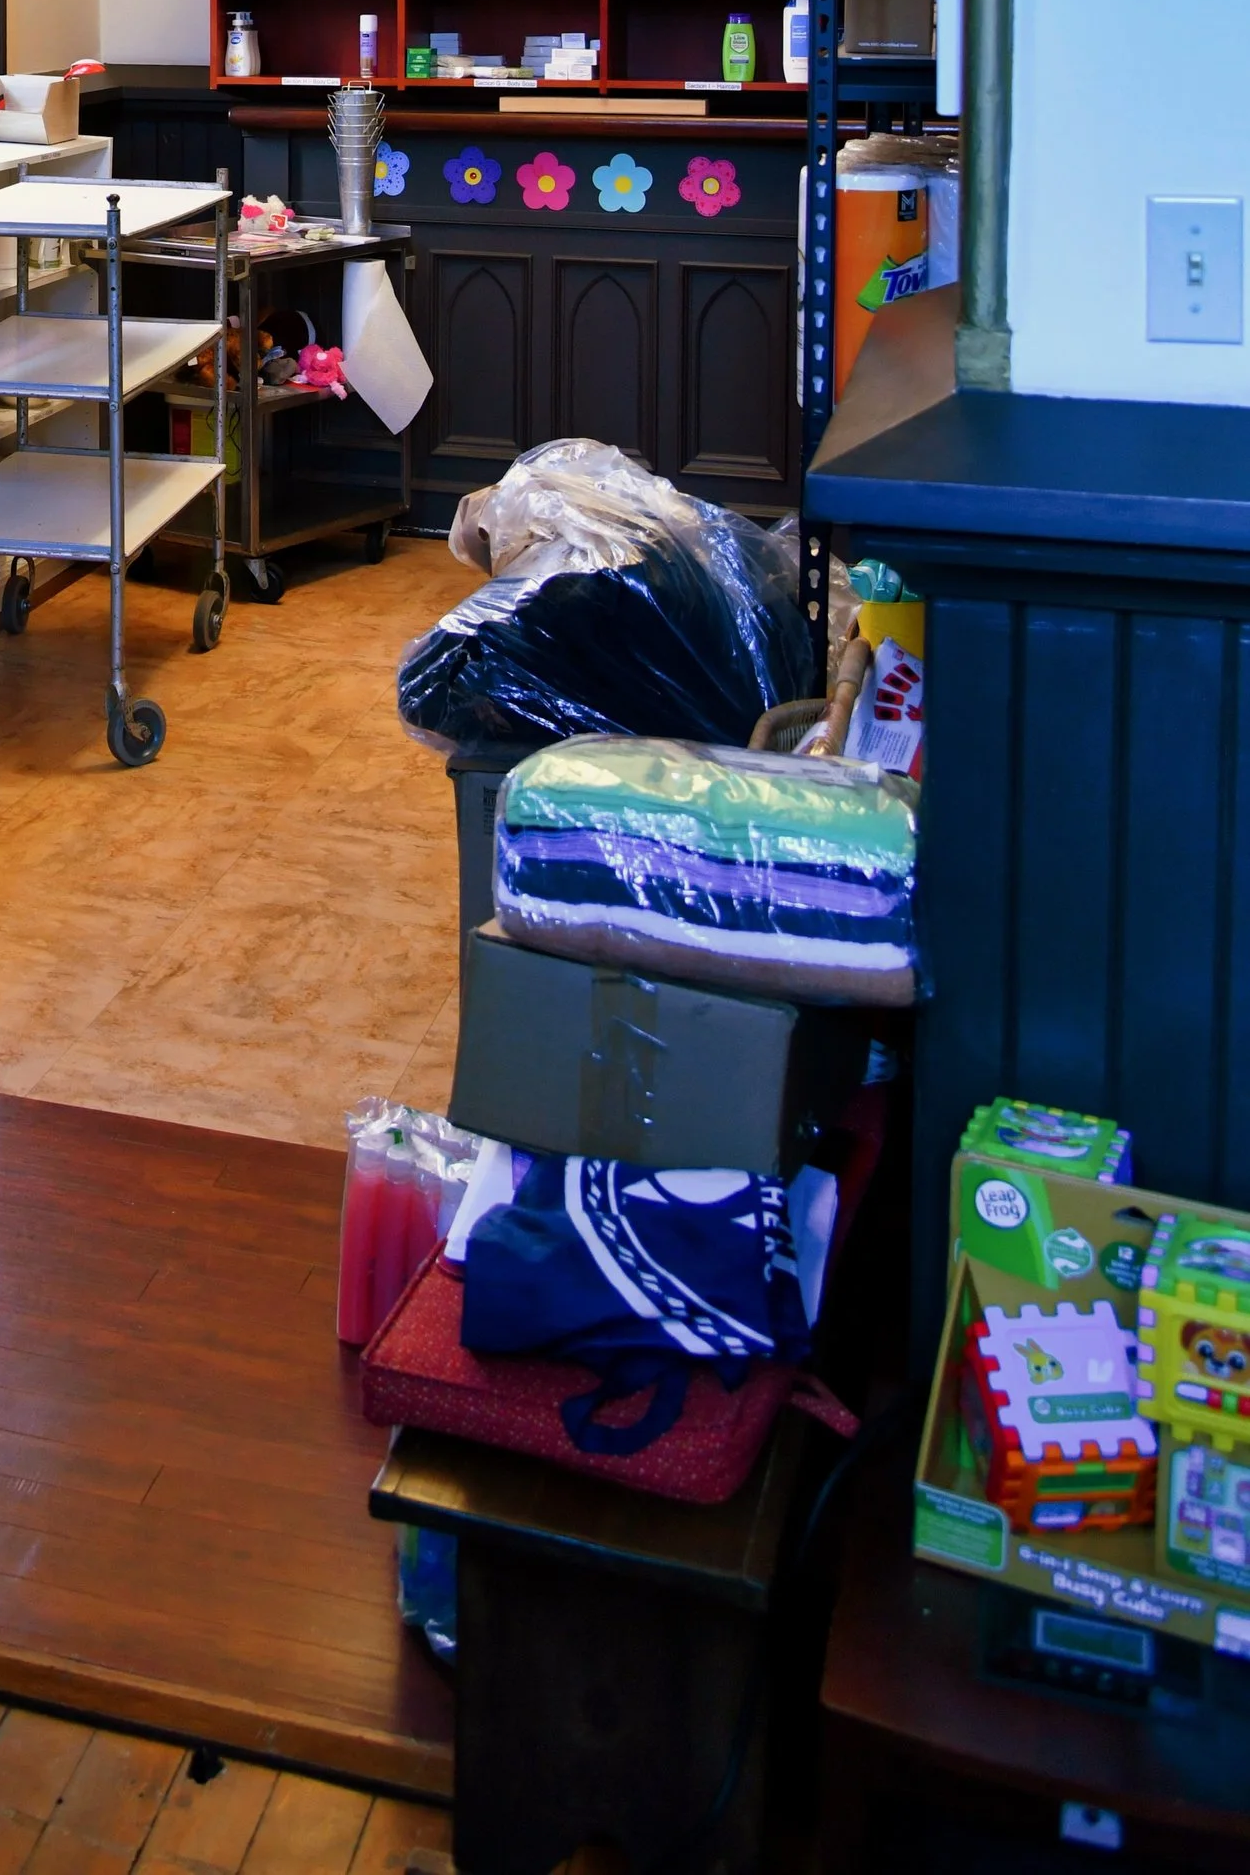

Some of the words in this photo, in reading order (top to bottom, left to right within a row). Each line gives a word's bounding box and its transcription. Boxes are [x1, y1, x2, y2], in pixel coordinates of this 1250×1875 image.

[980, 1188, 1017, 1204] Leap
[985, 1203, 1021, 1220] Frog
[1053, 1572, 1106, 1608] Busy
[1112, 1589, 1165, 1619] Cube
[1077, 1561, 1123, 1591] Snap
[1150, 1582, 1204, 1612] Learn
